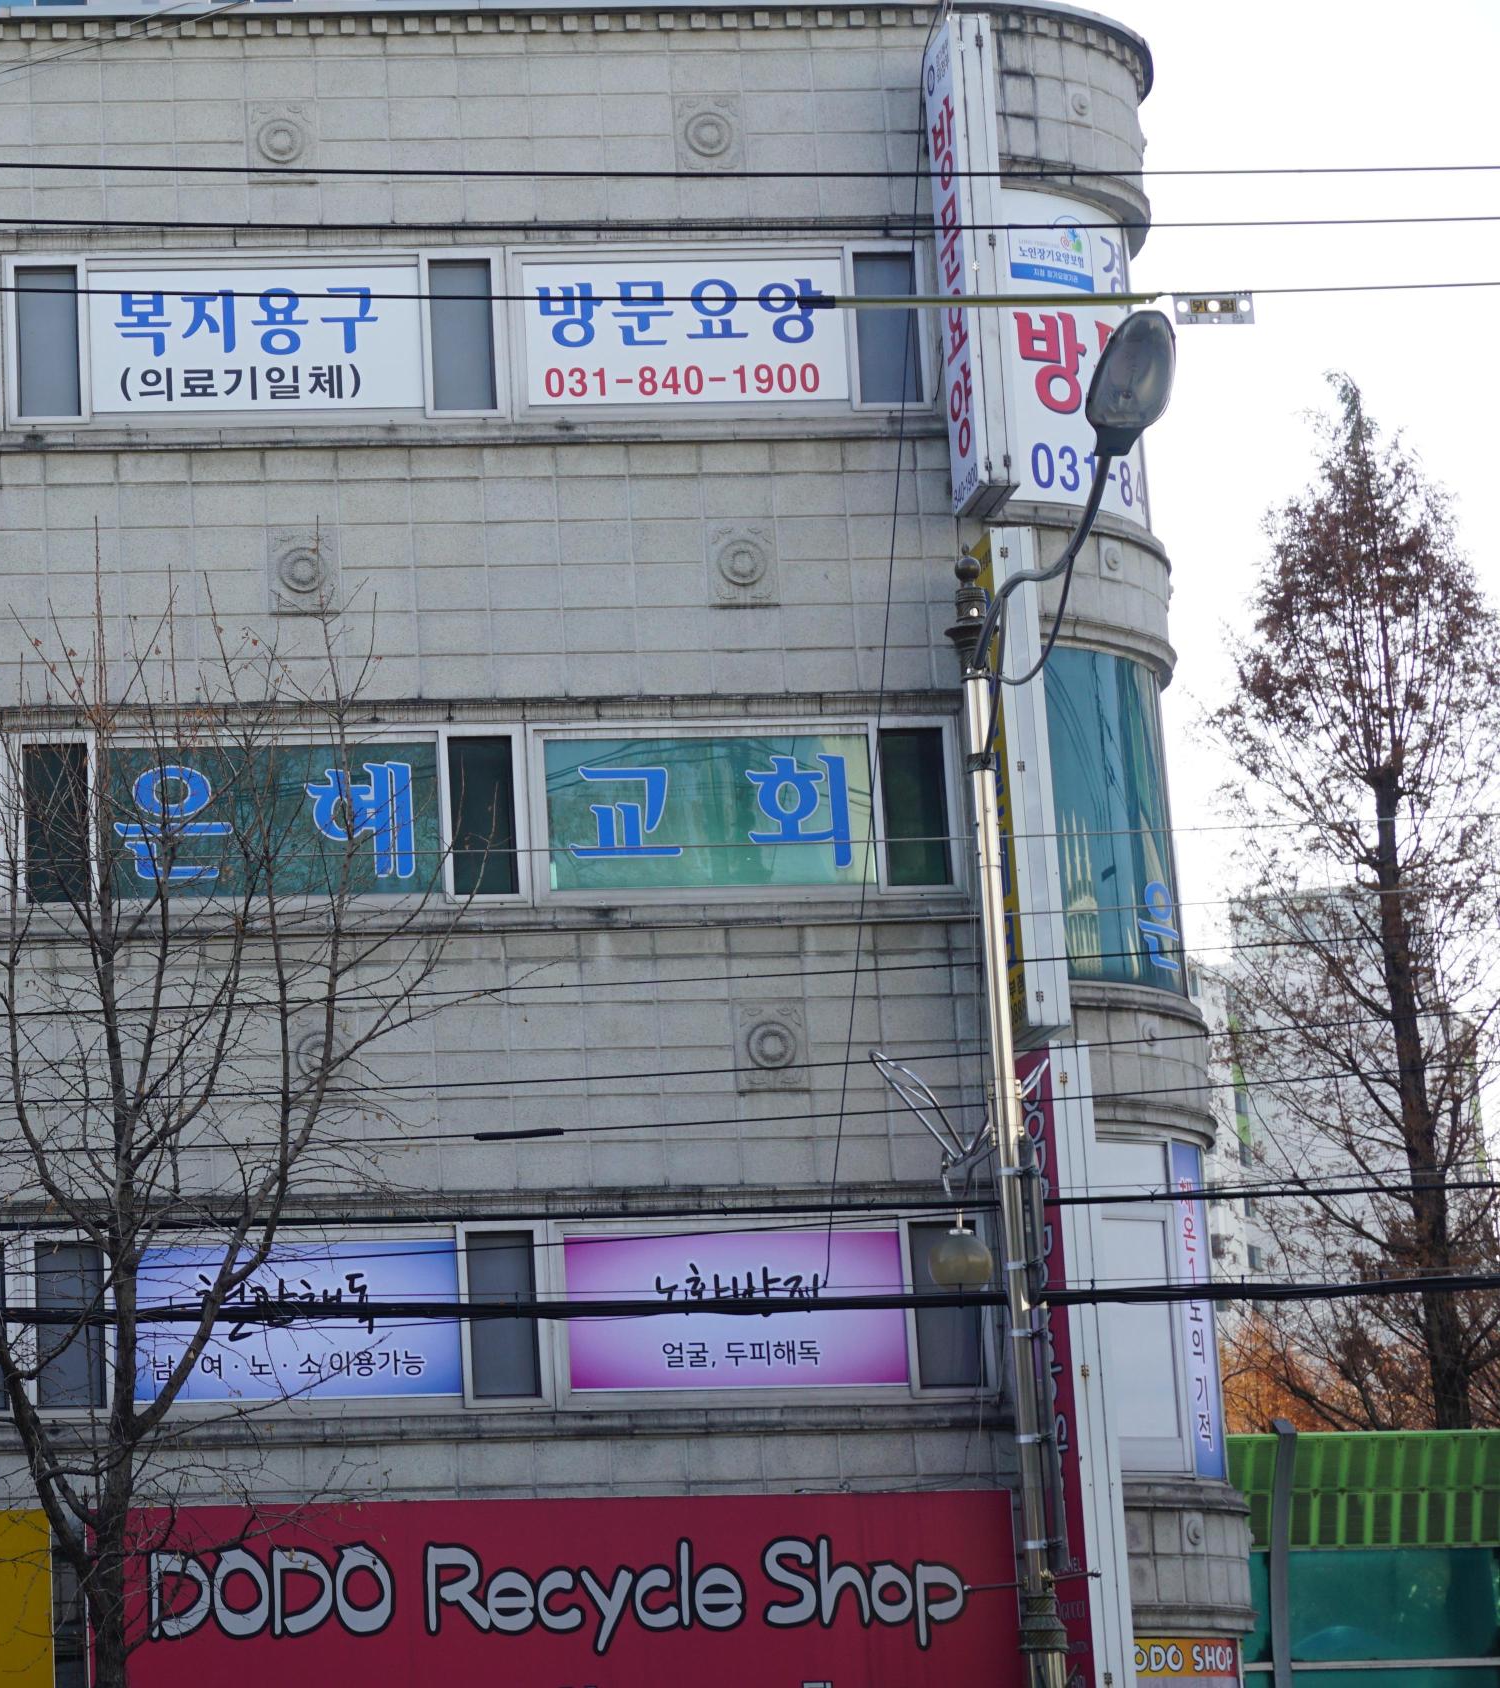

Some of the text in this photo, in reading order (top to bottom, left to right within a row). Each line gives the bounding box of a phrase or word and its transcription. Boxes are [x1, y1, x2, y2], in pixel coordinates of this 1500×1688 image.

[1018, 246, 1084, 268] 노인장기요양보험
[114, 287, 379, 357] 복지용구
[536, 278, 822, 347] 방문요양
[120, 364, 361, 402] (의료기일체)
[545, 363, 820, 398] 031-840-1900
[662, 1340, 820, 1369] 얼굴, 두피해독
[148, 1534, 968, 1656] DODO Recycle Shop
[1192, 1644, 1233, 1671] SHOP
